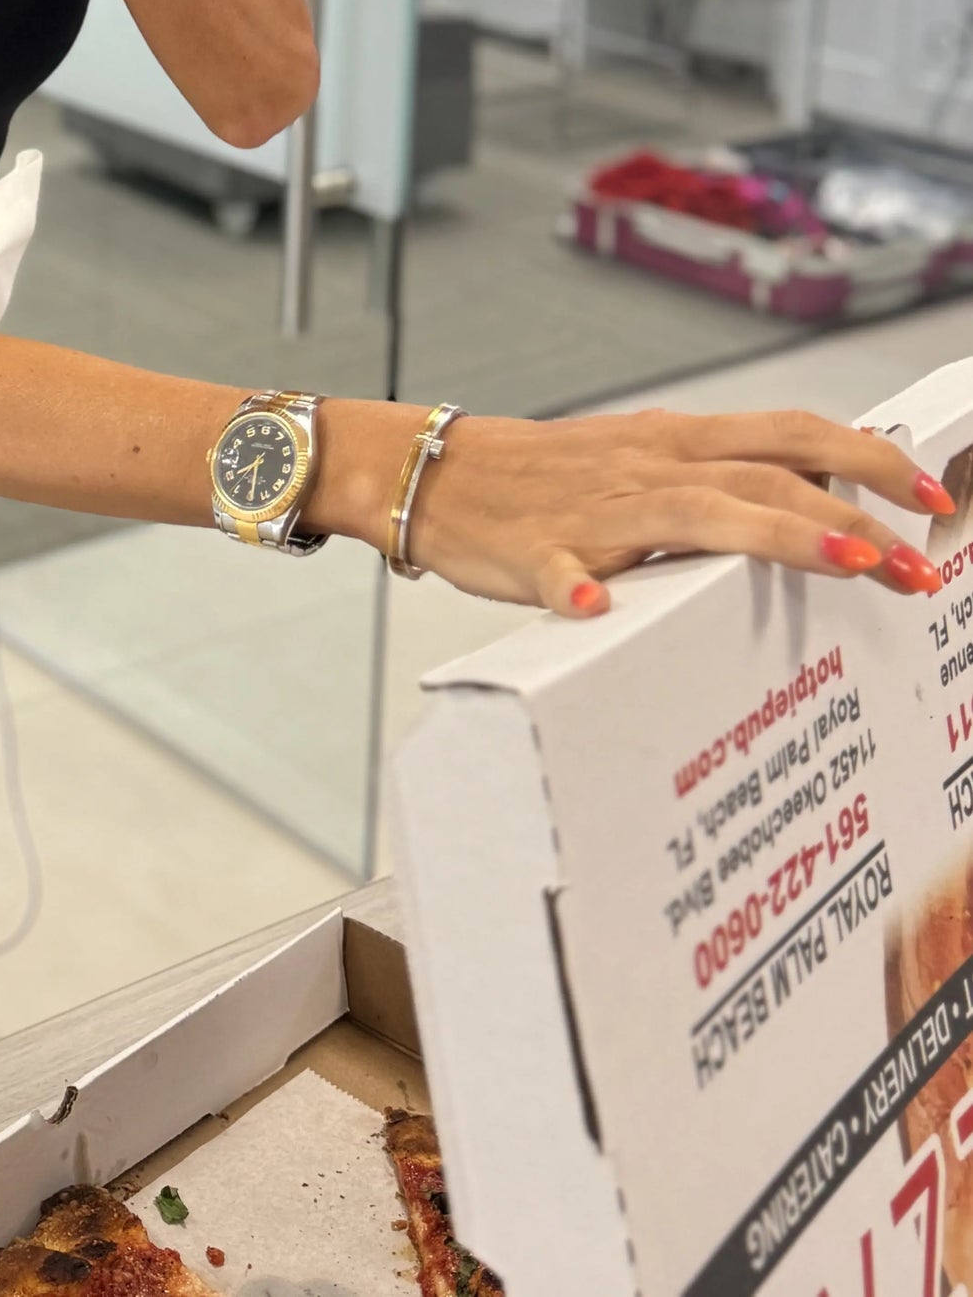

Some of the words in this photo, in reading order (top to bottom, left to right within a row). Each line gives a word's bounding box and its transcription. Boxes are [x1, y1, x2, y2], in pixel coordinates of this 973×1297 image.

[246, 426, 256, 438] 5
[274, 431, 285, 441] 7
[928, 614, 949, 652] FL
[673, 645, 844, 800] hotpiepub.com
[765, 728, 811, 784] Palm
[813, 687, 861, 753] Royal
[830, 728, 876, 791] 11452
[697, 769, 763, 843] Beach,
[717, 771, 827, 883] Okeechobee
[667, 826, 696, 871] FL
[693, 792, 870, 990] 561-422-0600
[828, 852, 893, 944] ROYAL
[770, 916, 829, 1009] PALM
[691, 977, 769, 1090] BEACH
[864, 1002, 952, 1136] DELIVERY
[745, 1120, 850, 1271] CATERING
